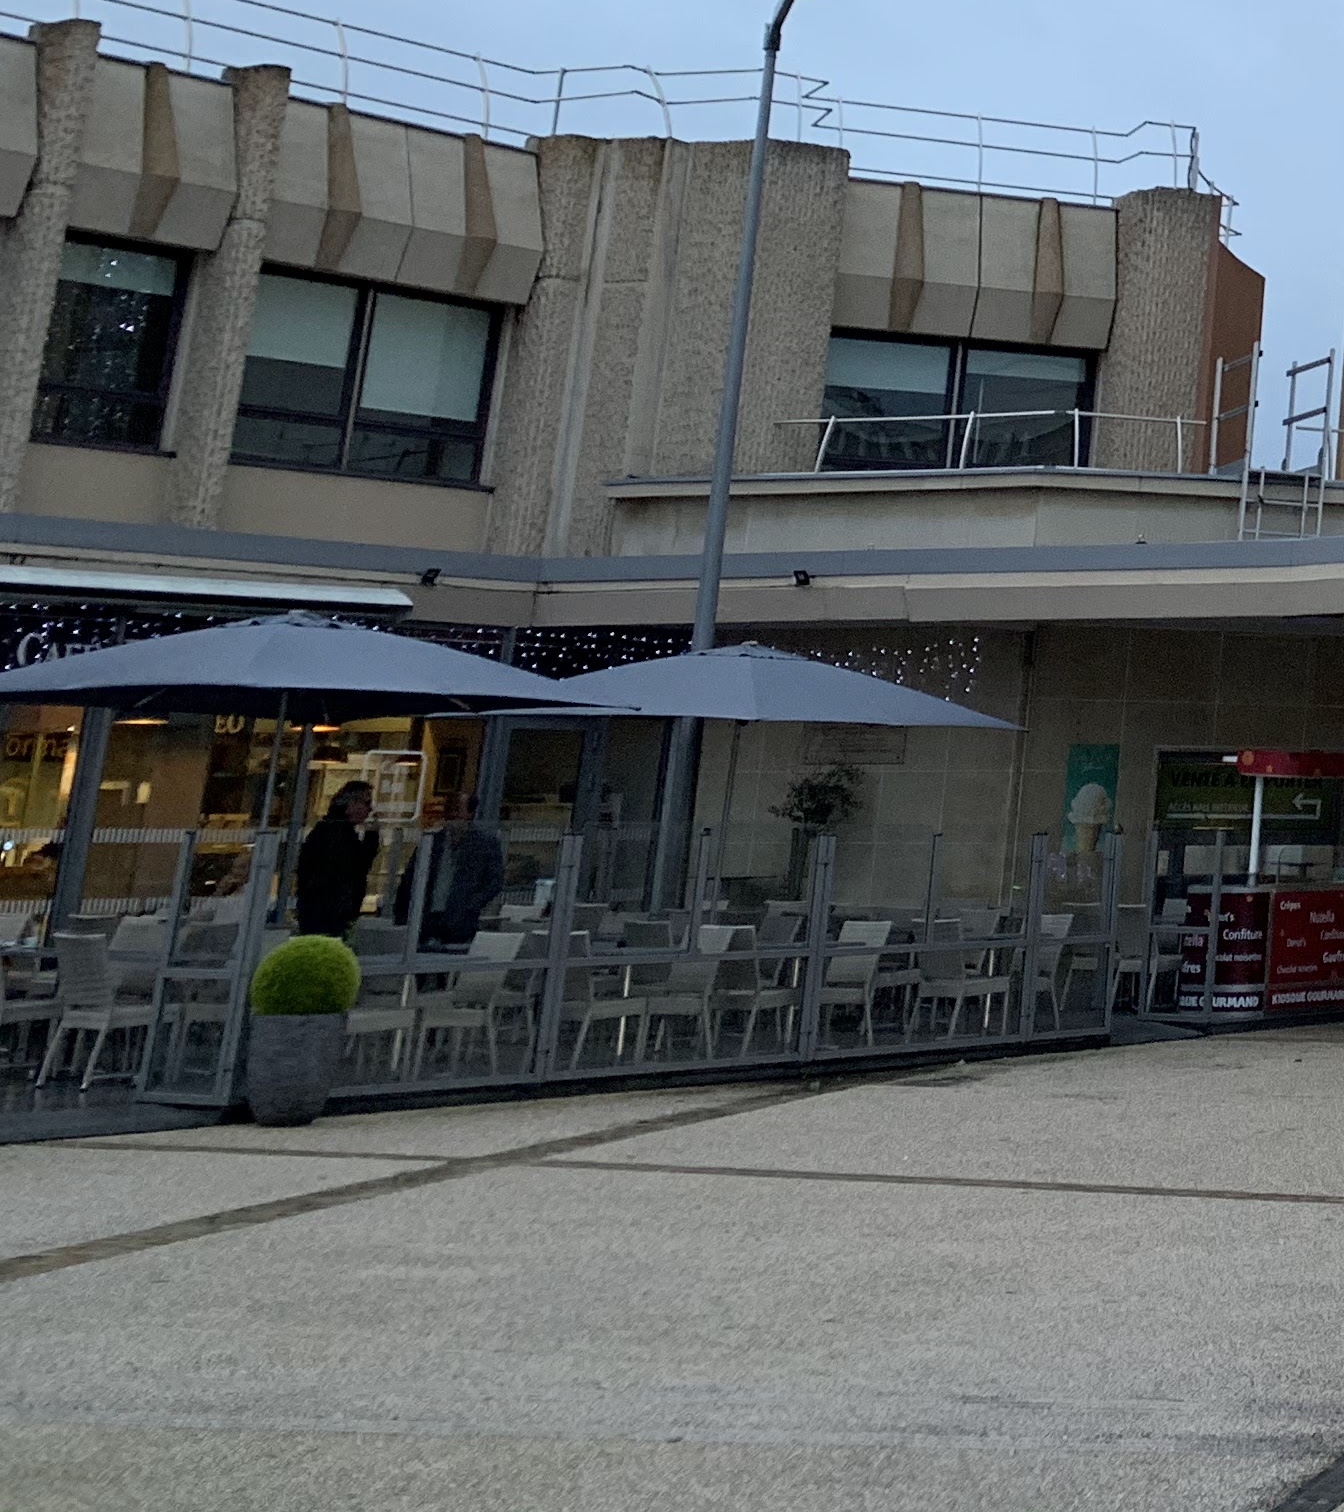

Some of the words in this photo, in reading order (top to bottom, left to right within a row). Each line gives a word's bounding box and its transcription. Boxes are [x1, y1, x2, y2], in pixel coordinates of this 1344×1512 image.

[1309, 909, 1336, 924] Nutella
[1223, 928, 1263, 941] Confiture
[1199, 995, 1260, 1008] GURMAND
[1271, 991, 1306, 1006] KIOSQUE
